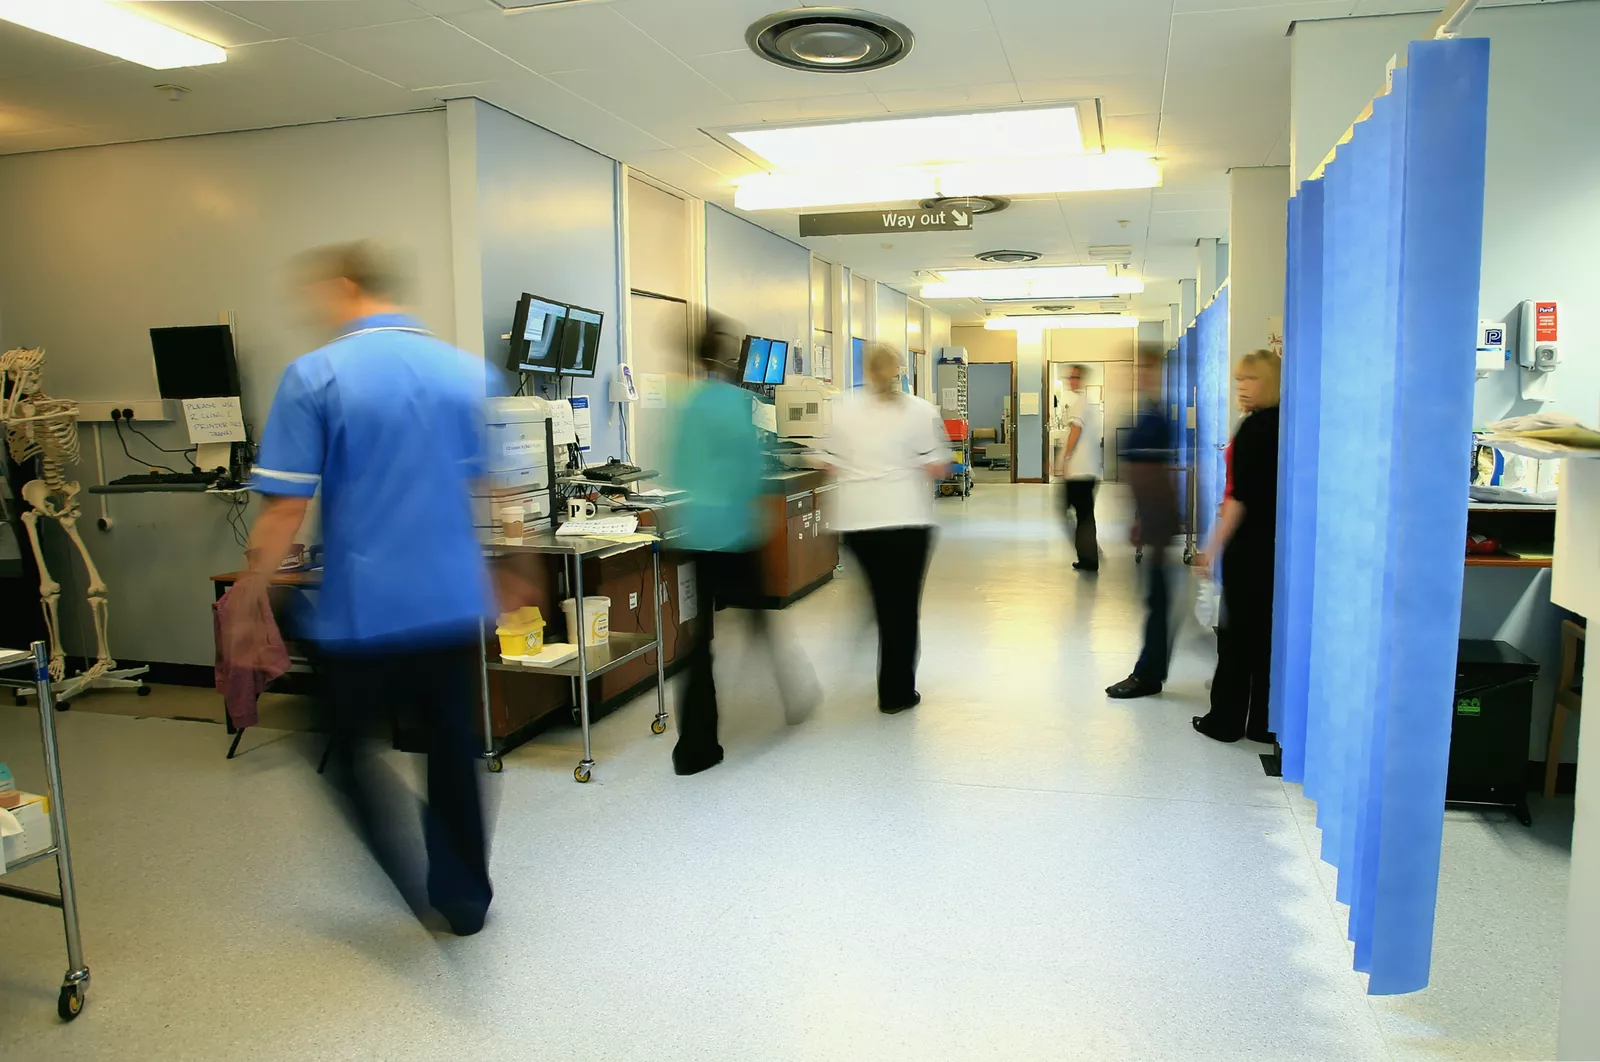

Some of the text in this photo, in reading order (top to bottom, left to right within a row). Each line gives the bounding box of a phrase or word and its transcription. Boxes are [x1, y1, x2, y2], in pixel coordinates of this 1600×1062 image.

[882, 210, 946, 229] Way out
[570, 504, 580, 518] P
